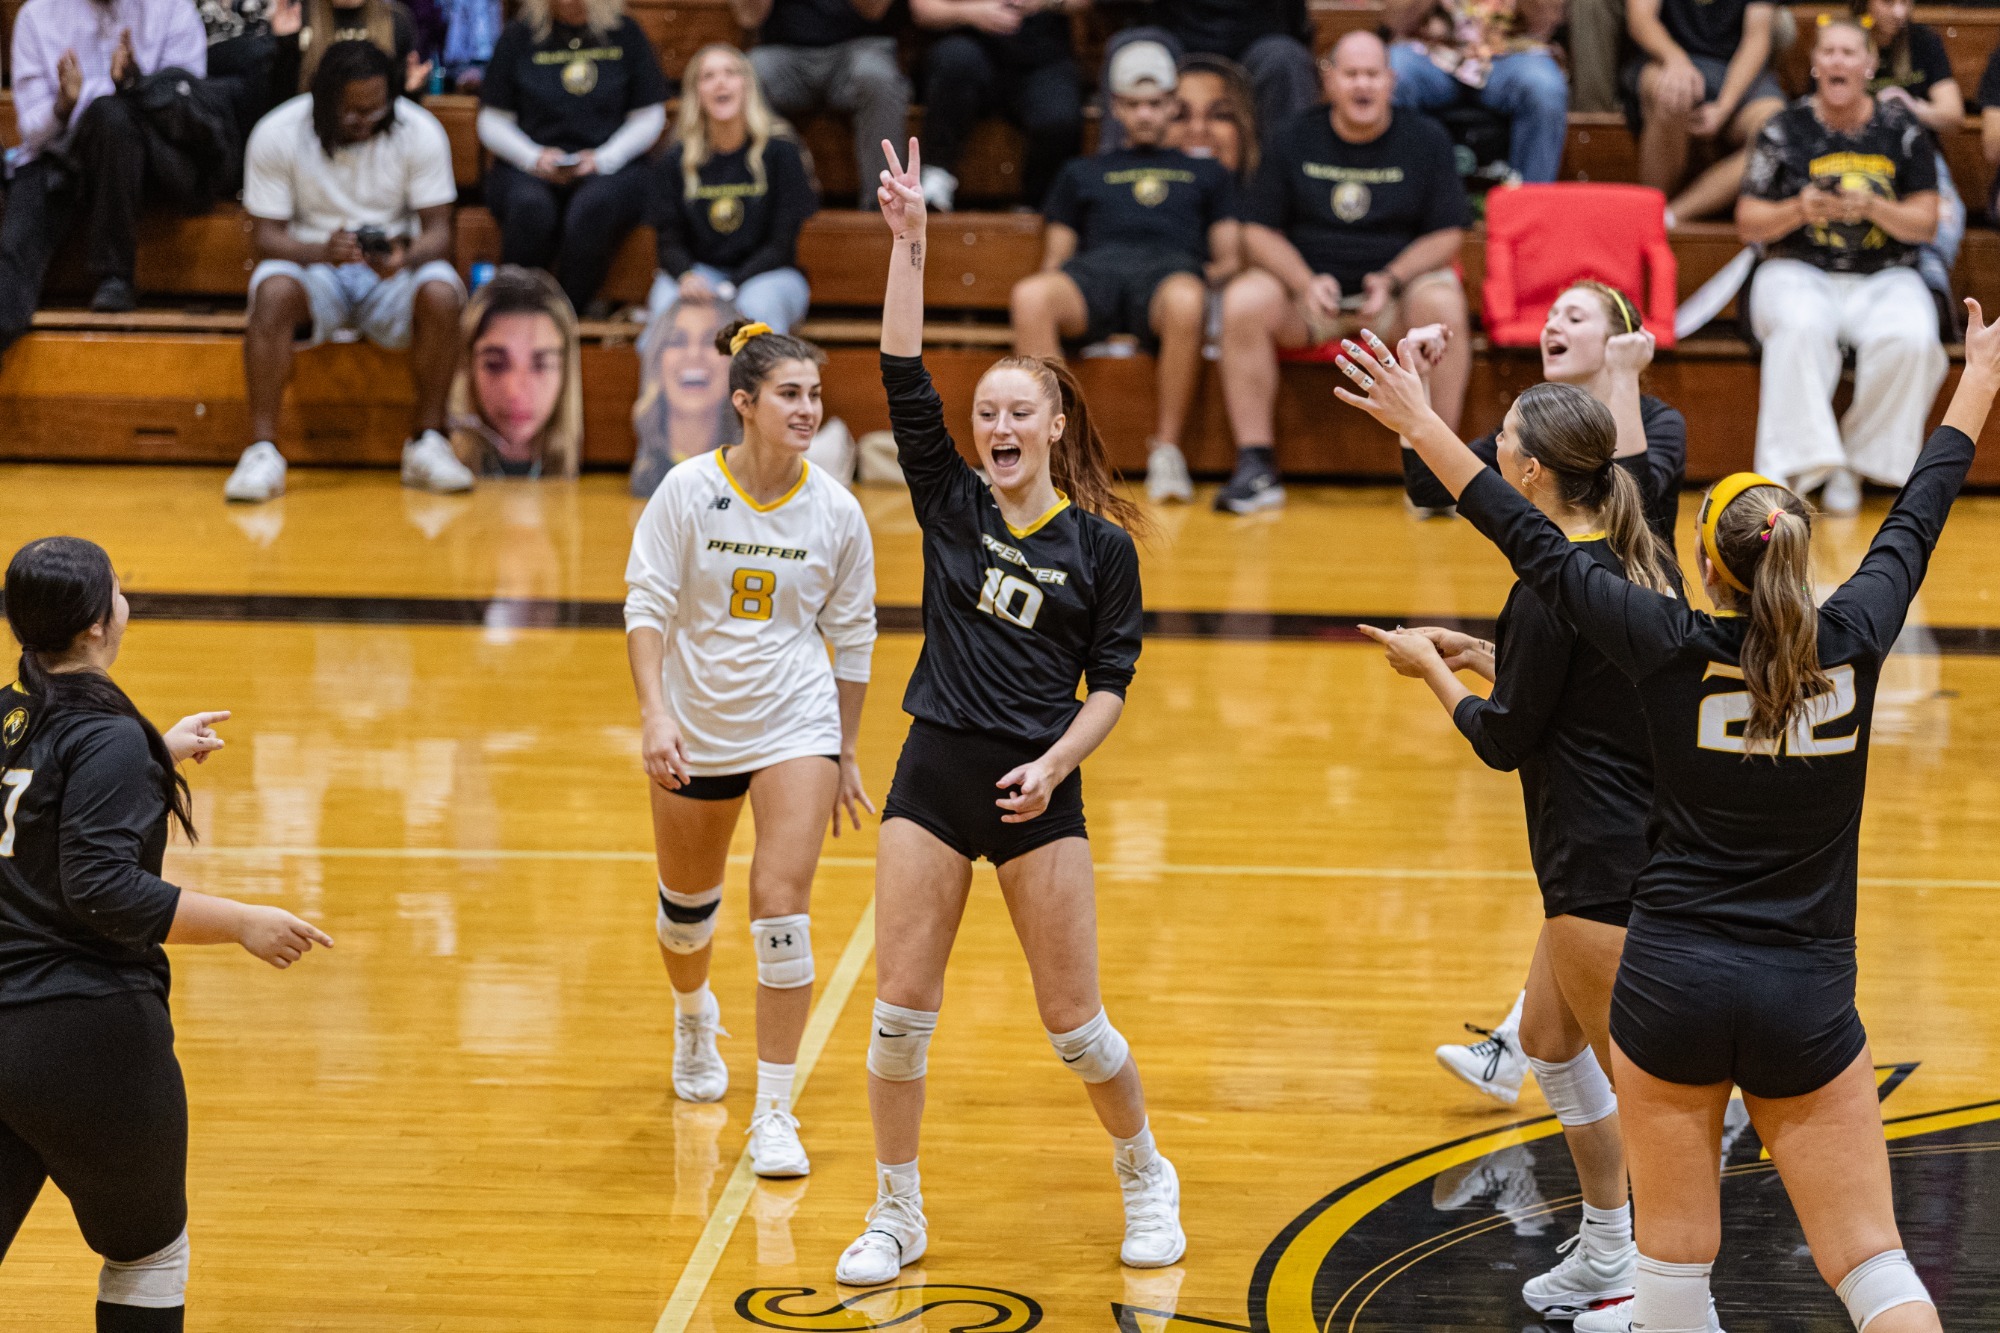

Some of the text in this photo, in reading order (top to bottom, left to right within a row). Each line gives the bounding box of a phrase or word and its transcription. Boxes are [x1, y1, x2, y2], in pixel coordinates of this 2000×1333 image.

[707, 539, 808, 560] PFEIFFER
[981, 533, 1068, 585] PFEIER
[729, 567, 777, 621] 8
[976, 567, 1044, 629] 10
[1697, 661, 1859, 757] 22
[0, 766, 34, 857] 7
